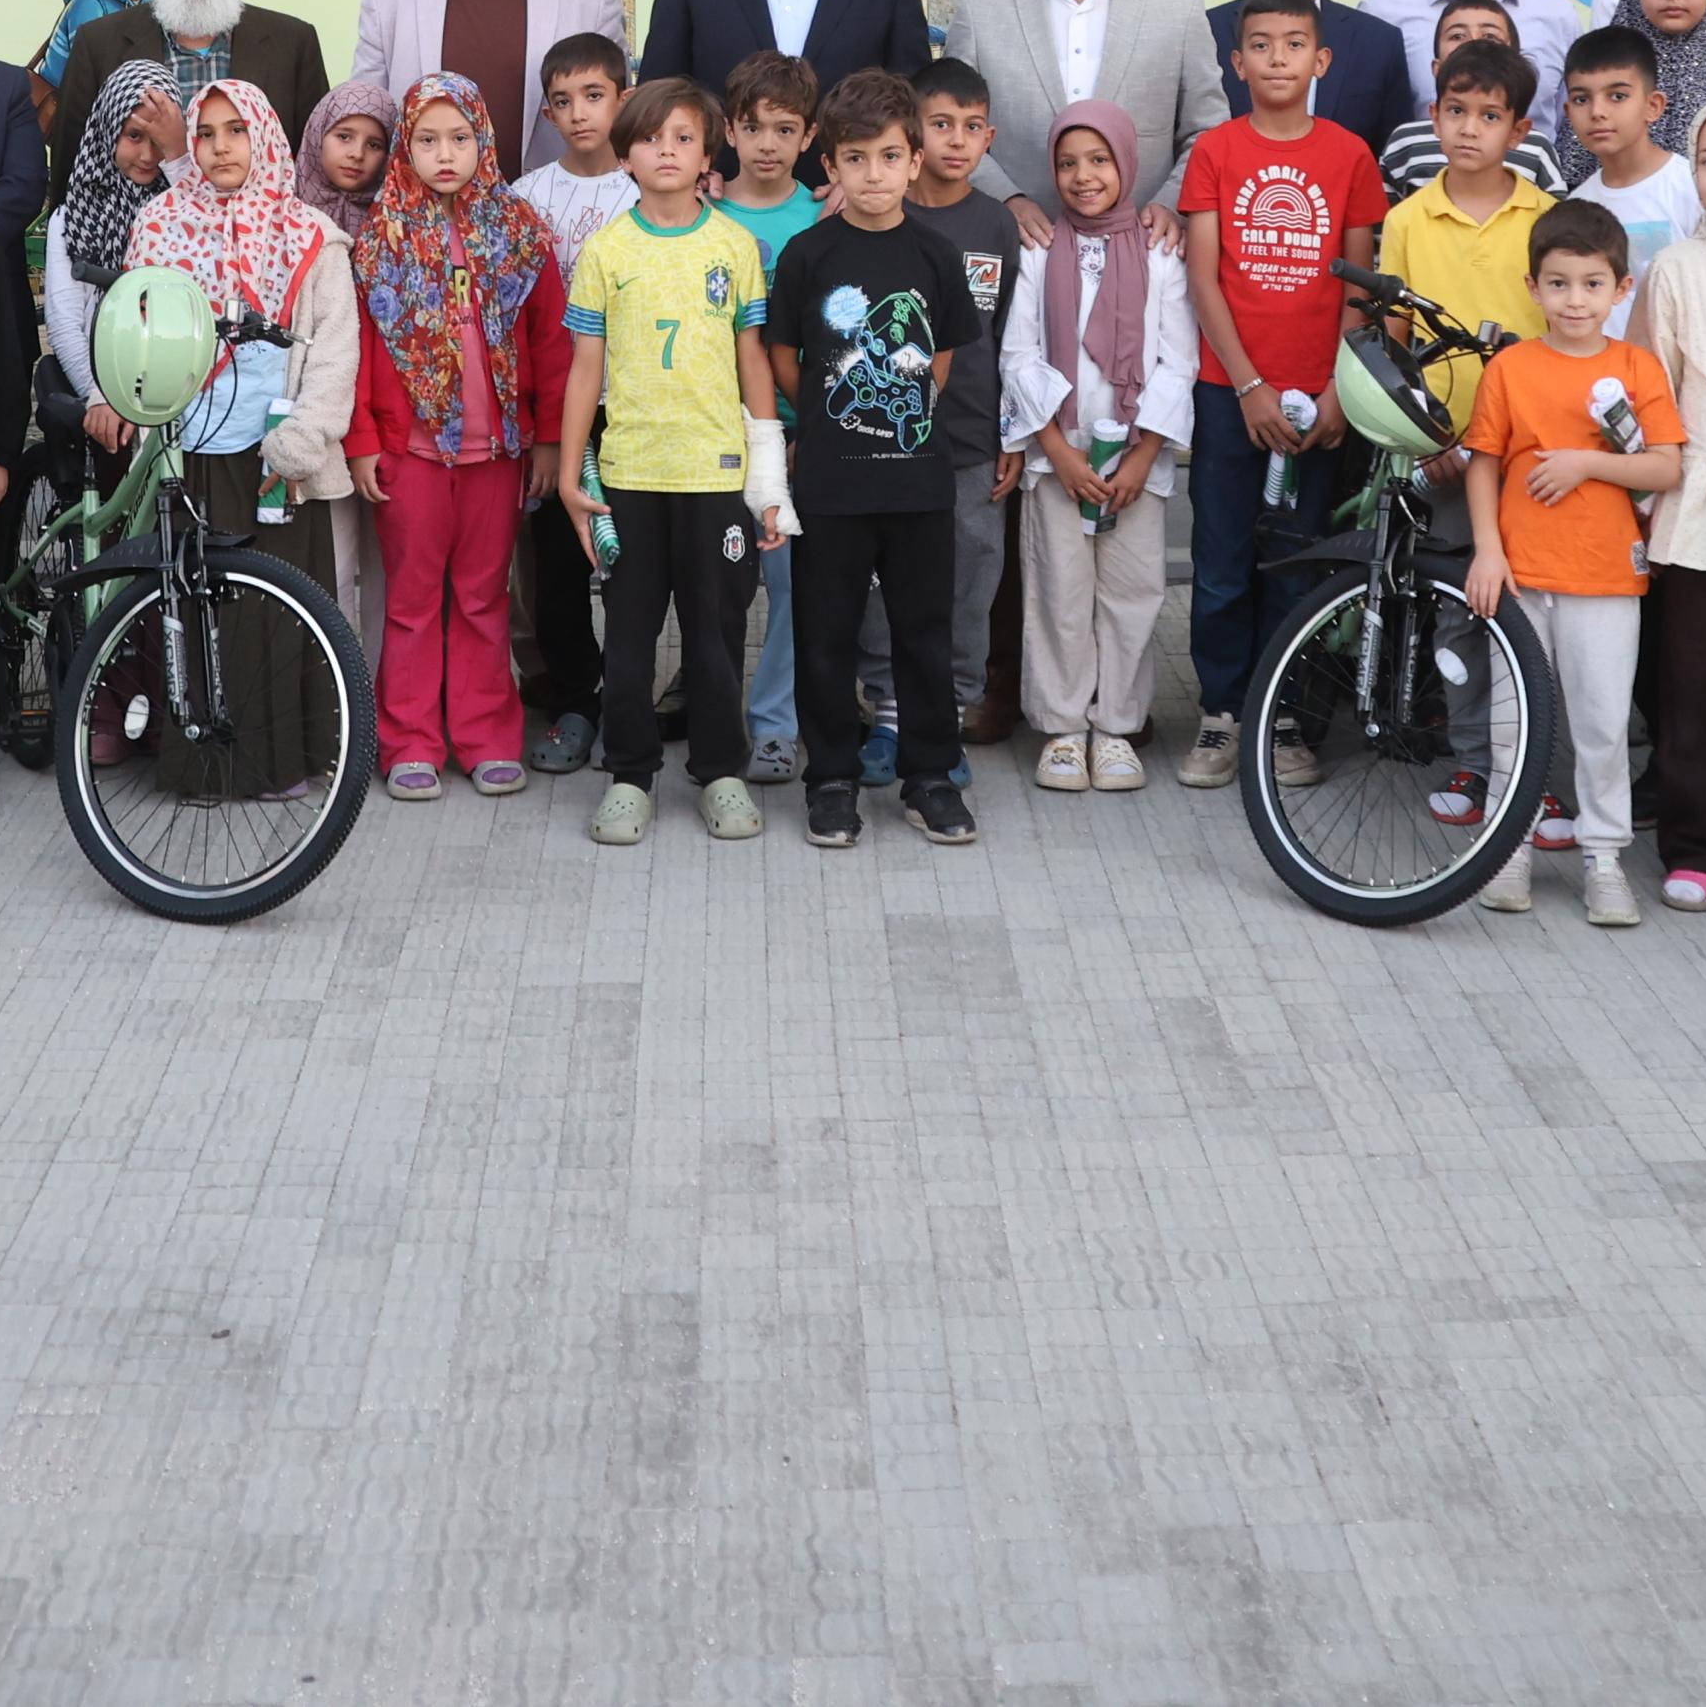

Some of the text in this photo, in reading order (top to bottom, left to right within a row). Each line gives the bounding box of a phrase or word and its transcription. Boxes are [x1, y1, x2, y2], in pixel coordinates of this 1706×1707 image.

[1233, 178, 1257, 215] SURF
[1258, 165, 1307, 187] SMALL
[1241, 228, 1321, 248] CALM DOWN
[1248, 245, 1268, 256] FEEL
[1272, 246, 1289, 257] THE
[1291, 248, 1320, 261] SOUND
[656, 319, 681, 370] 7
